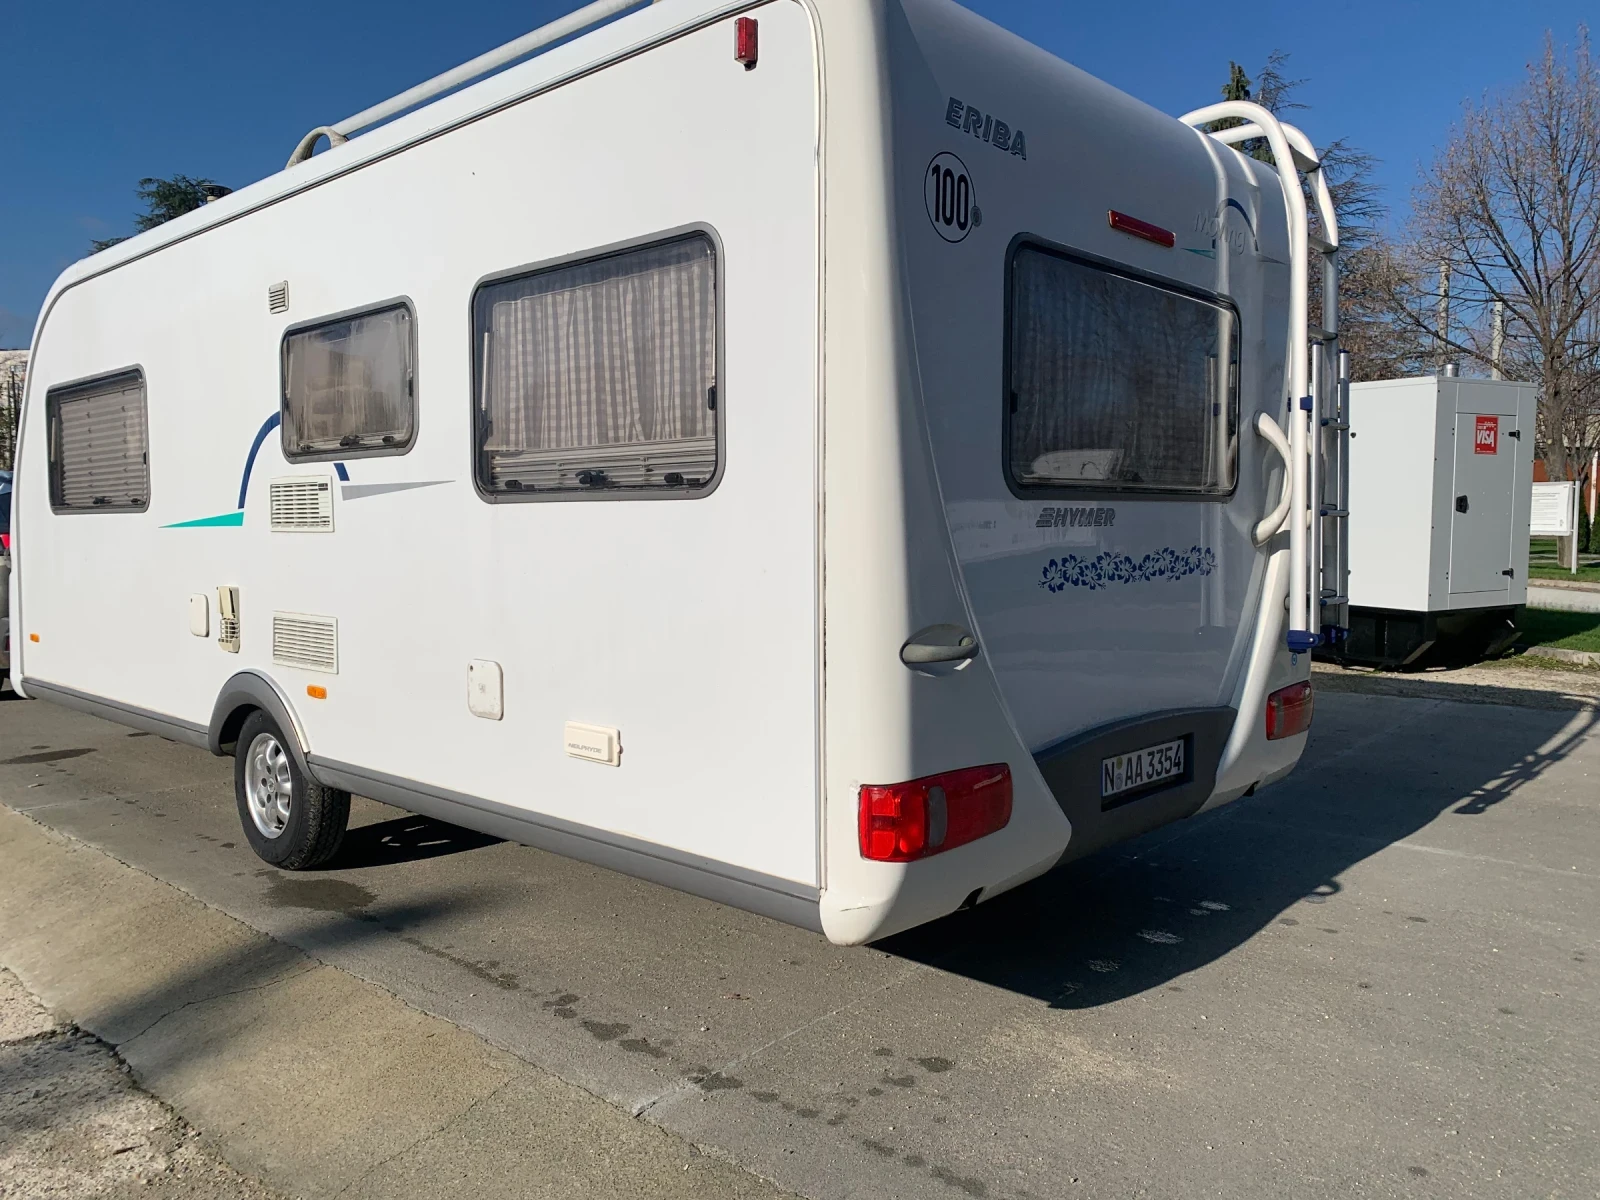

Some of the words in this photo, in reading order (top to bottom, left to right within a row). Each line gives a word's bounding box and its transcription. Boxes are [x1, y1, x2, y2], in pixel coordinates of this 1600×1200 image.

[945, 97, 1027, 161] ERIBA
[932, 163, 969, 231] 100
[1477, 430, 1495, 447] VISA
[1053, 508, 1115, 527] HYMER
[1146, 744, 1181, 779] 3354
